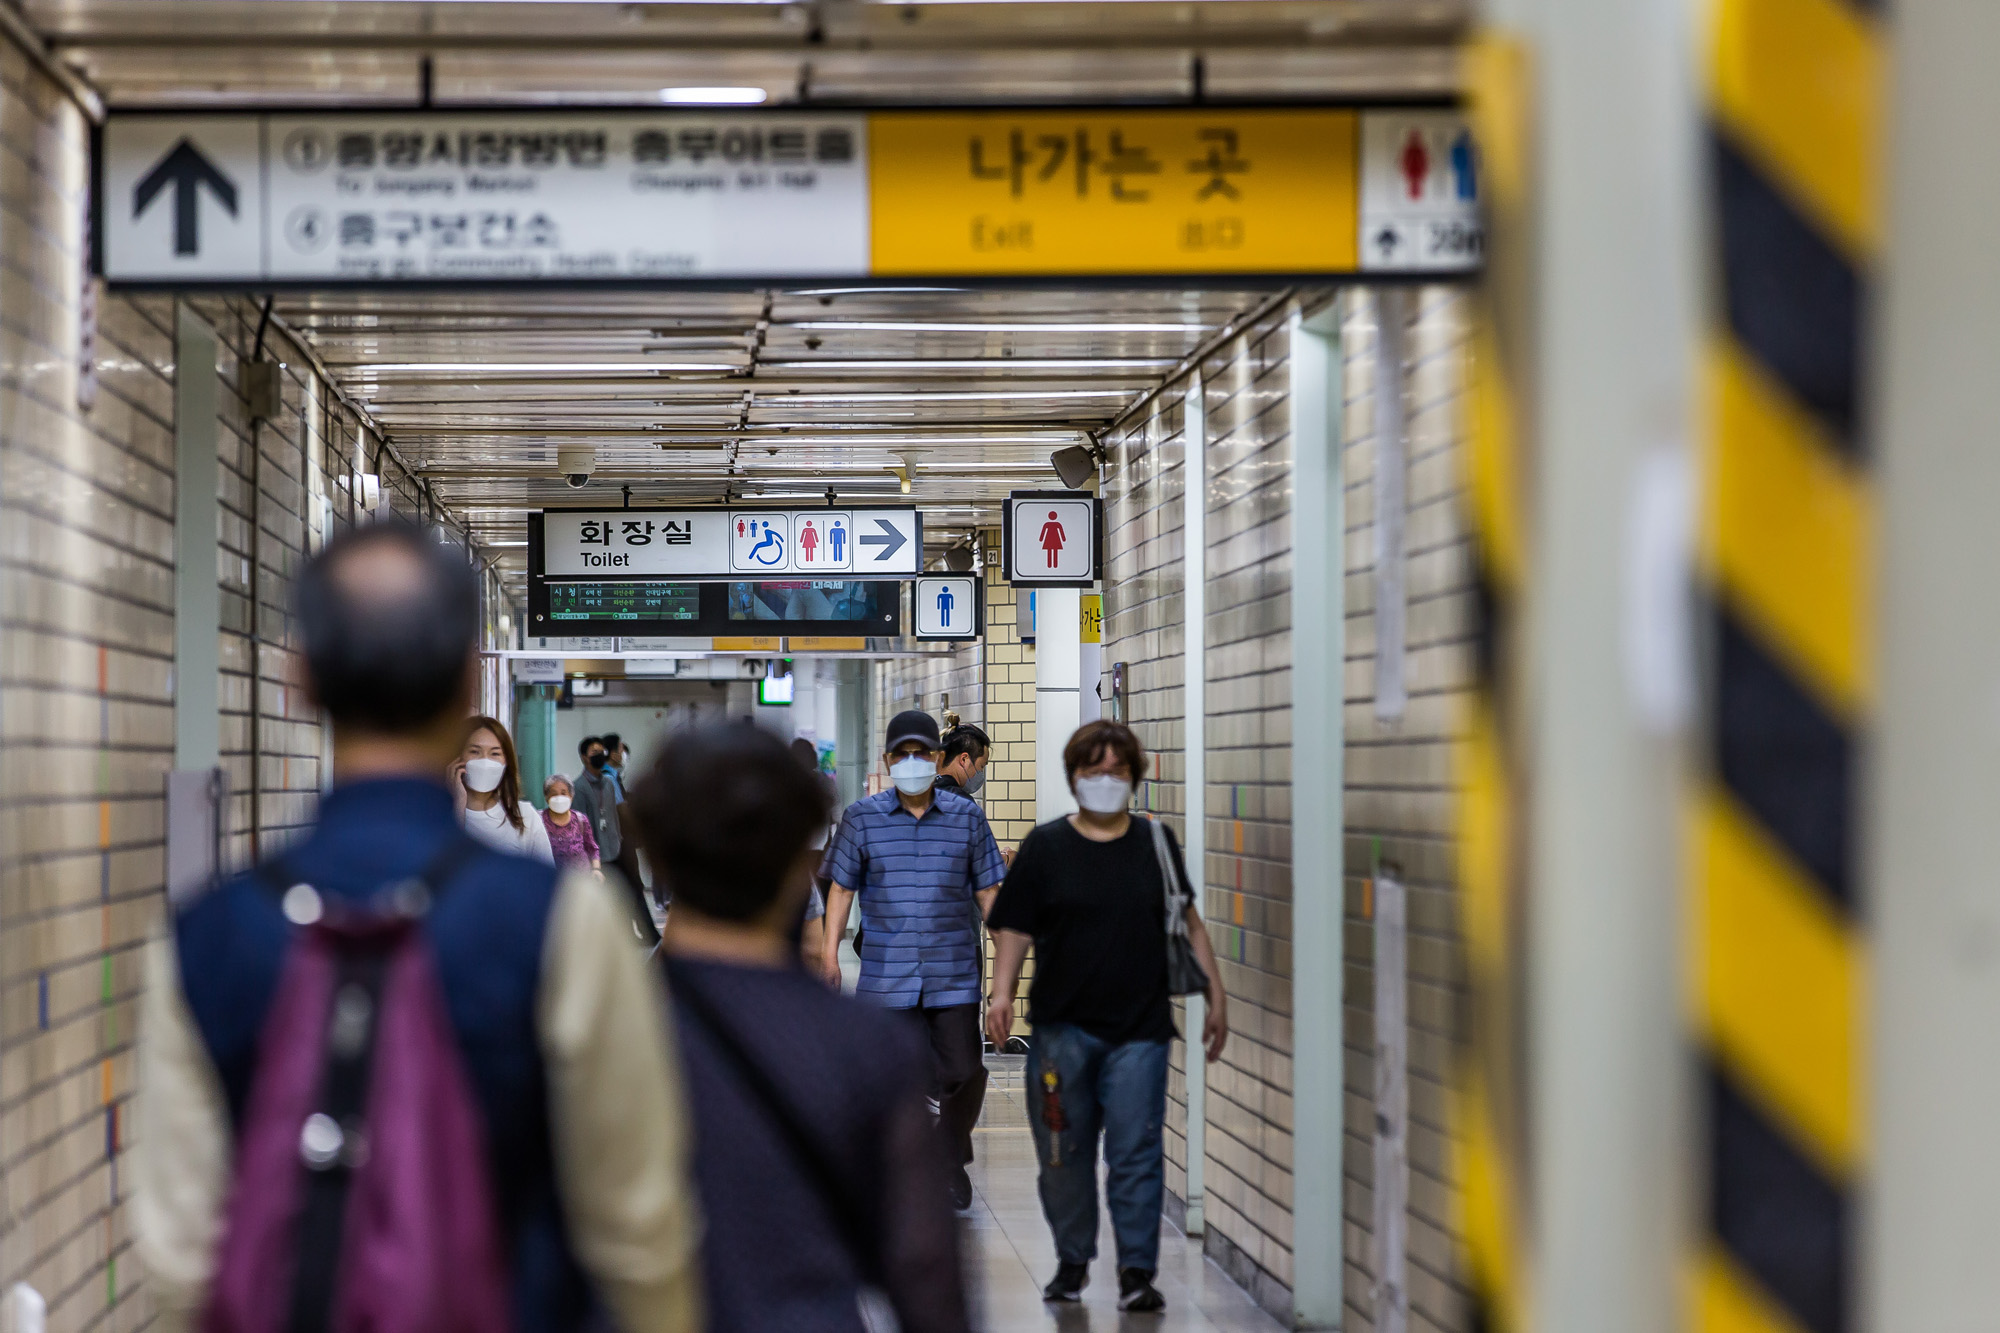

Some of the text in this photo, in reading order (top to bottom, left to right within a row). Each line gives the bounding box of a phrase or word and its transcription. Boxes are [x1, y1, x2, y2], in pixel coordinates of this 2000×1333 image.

[969, 126, 1250, 204] 나가는 곳
[580, 520, 691, 546] 화장실
[580, 552, 630, 567] Toilet
[988, 552, 997, 562] 21
